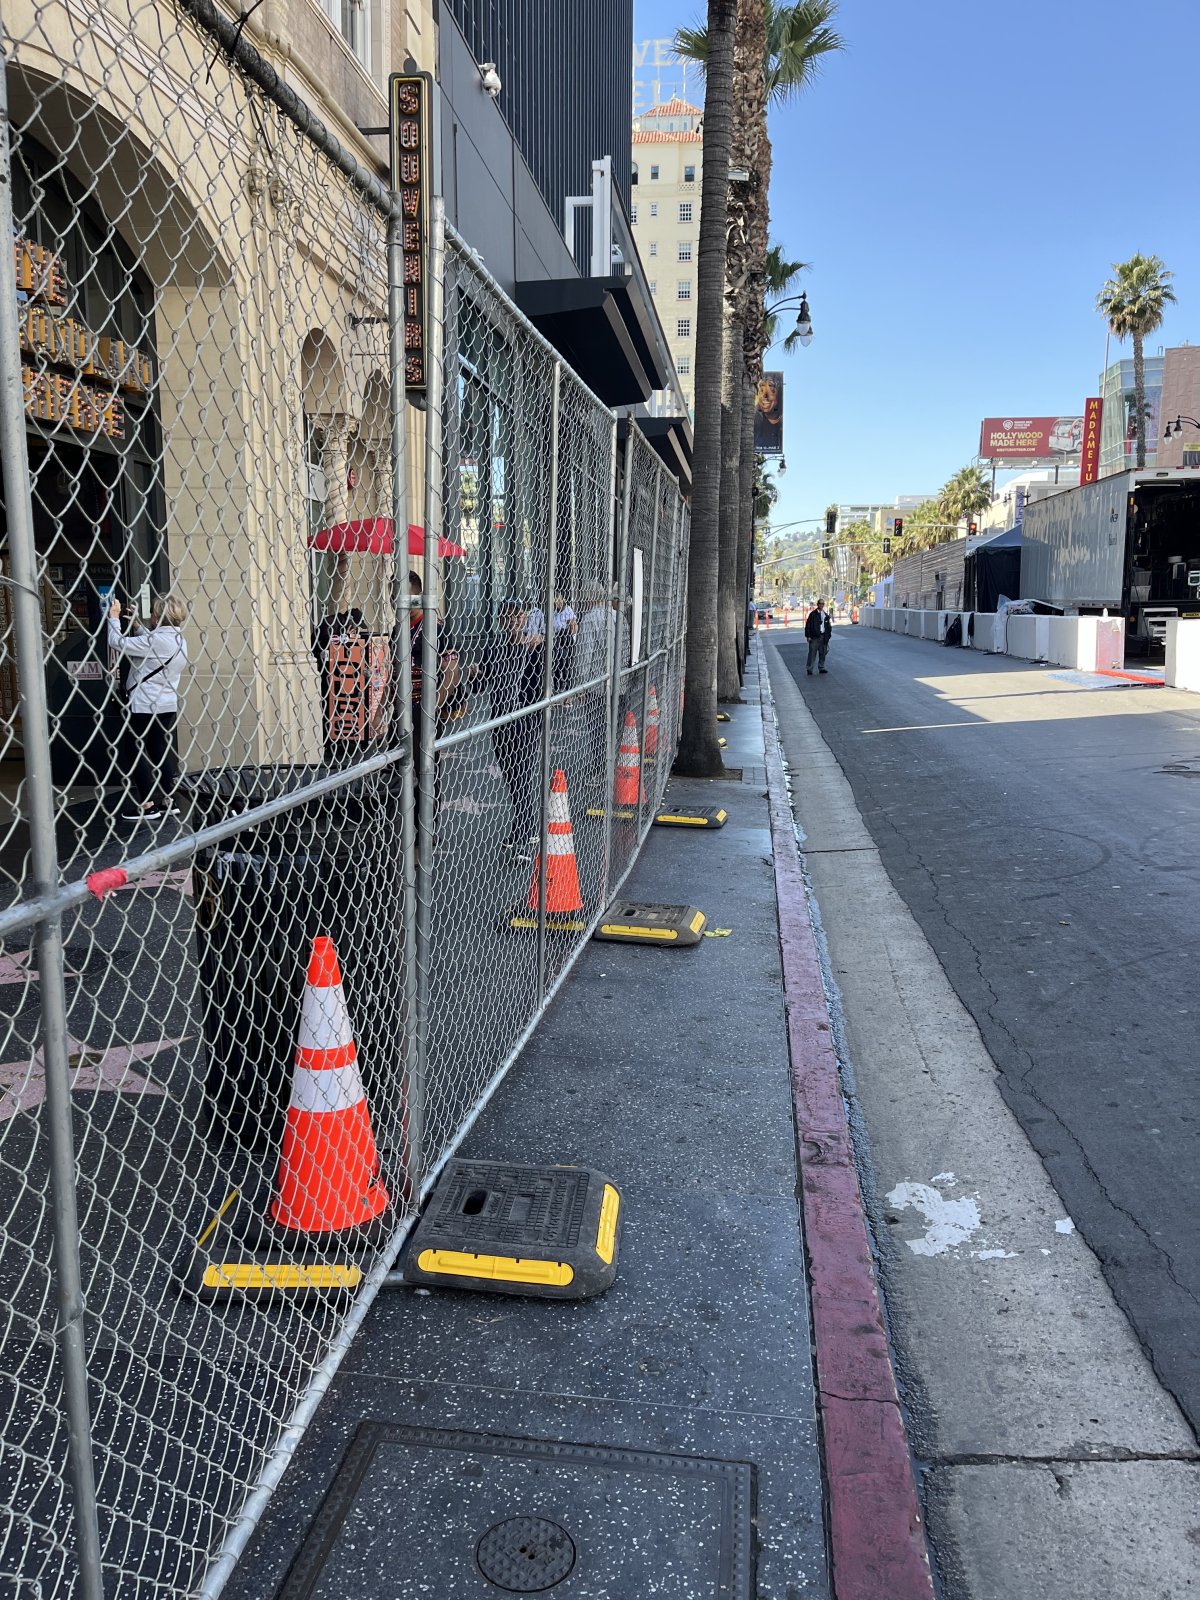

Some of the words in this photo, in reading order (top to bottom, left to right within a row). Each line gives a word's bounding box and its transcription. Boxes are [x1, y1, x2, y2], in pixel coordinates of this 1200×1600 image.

[399, 83, 421, 383] SOUVENIRS
[990, 431, 1043, 441] HOLLYWOOD
[1087, 401, 1098, 459] MADAME
[990, 439, 1015, 447] MADE
[1016, 438, 1038, 446] HERE
[71, 662, 100, 674] ATM
